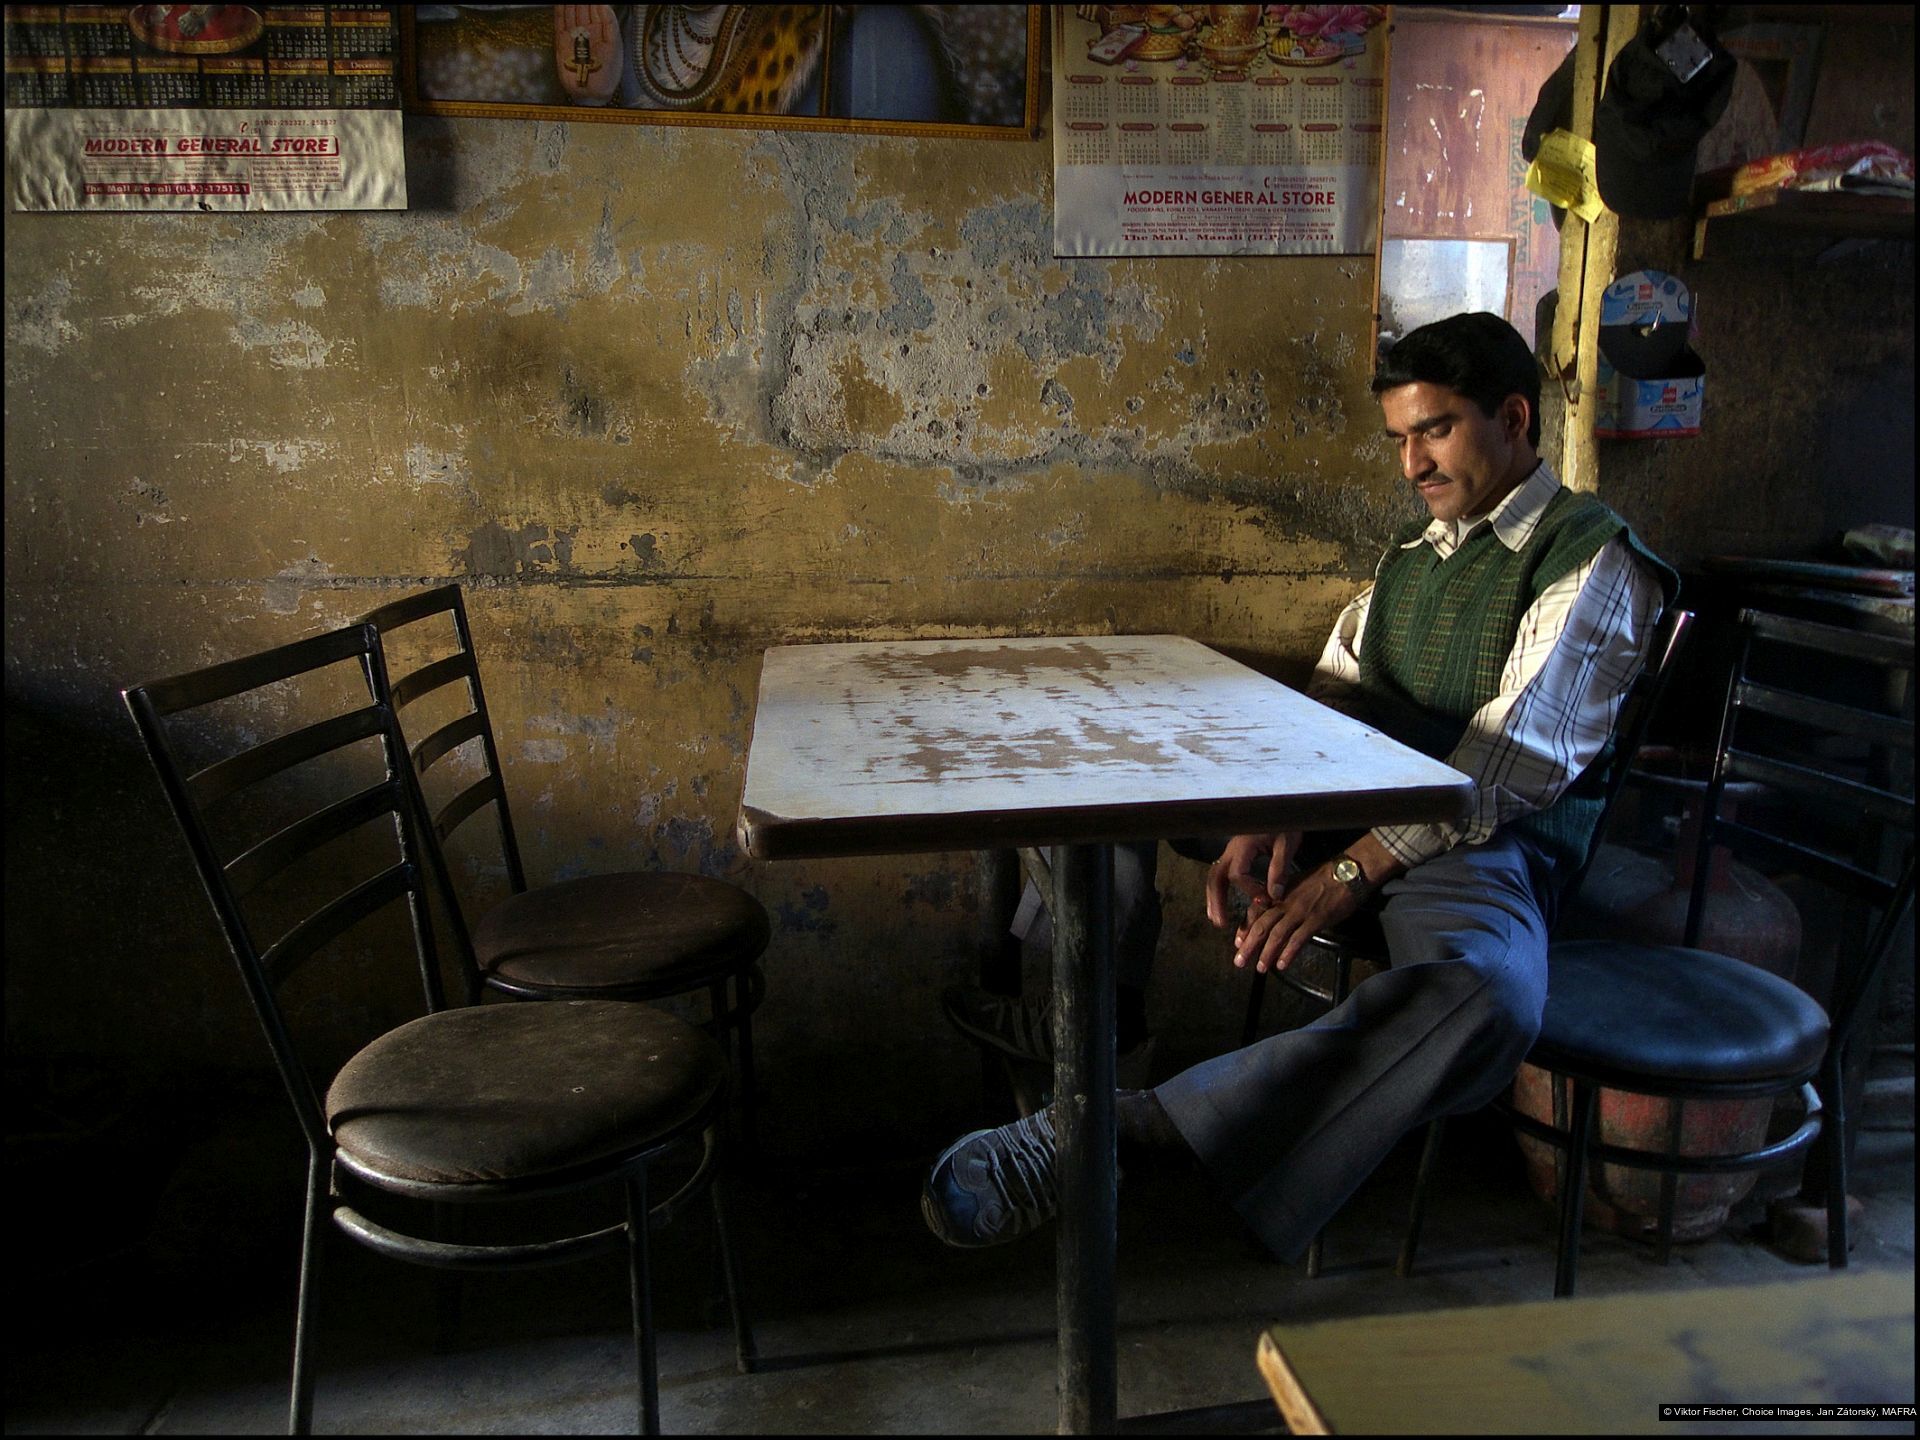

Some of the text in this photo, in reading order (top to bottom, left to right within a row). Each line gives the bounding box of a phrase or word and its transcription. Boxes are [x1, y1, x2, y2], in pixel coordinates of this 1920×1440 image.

[85, 138, 330, 153] MODERN GENERAL STORE
[107, 184, 130, 193] Mall
[1123, 190, 1335, 205] MODERN GENERAL STORE
[1122, 233, 1149, 241] The
[1197, 233, 1243, 241] Manali
